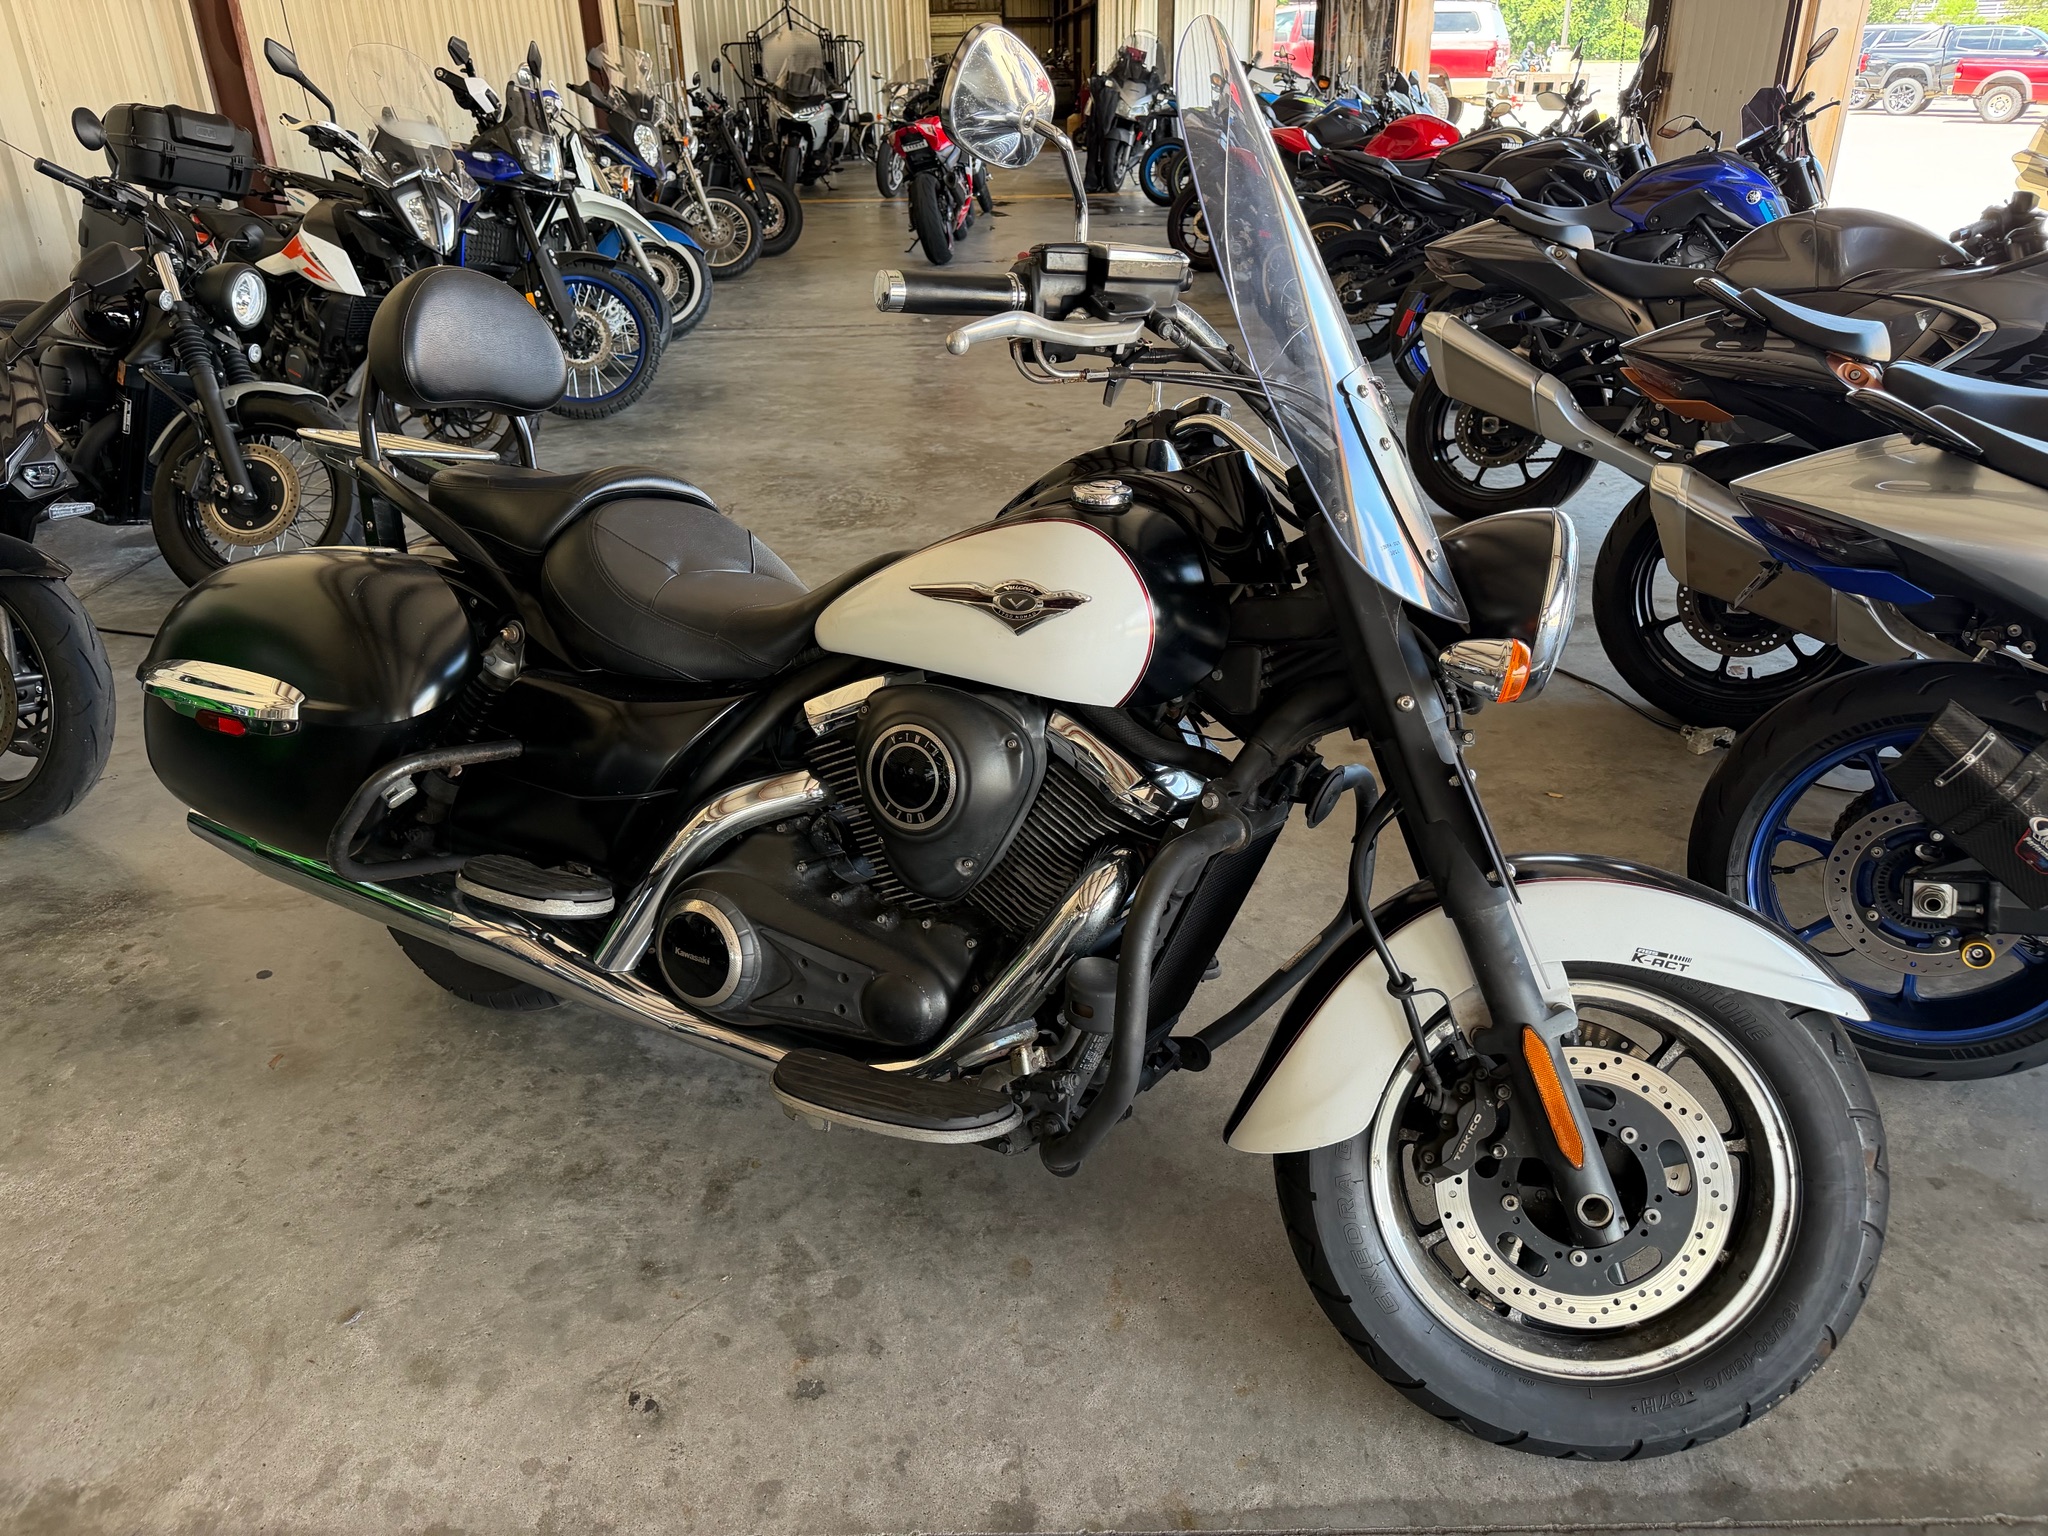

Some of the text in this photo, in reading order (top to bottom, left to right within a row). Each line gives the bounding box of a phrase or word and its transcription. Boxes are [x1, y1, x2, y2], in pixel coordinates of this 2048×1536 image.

[1003, 584, 1035, 594] Vulcan
[1014, 611, 1037, 619] NOMAD
[884, 801, 925, 824] 1700
[675, 946, 710, 966] Kawasaki
[1631, 952, 1690, 972] K-ACT
[1453, 1113, 1482, 1160] TOKICO
[1334, 1172, 1400, 1315] EXEDRA
